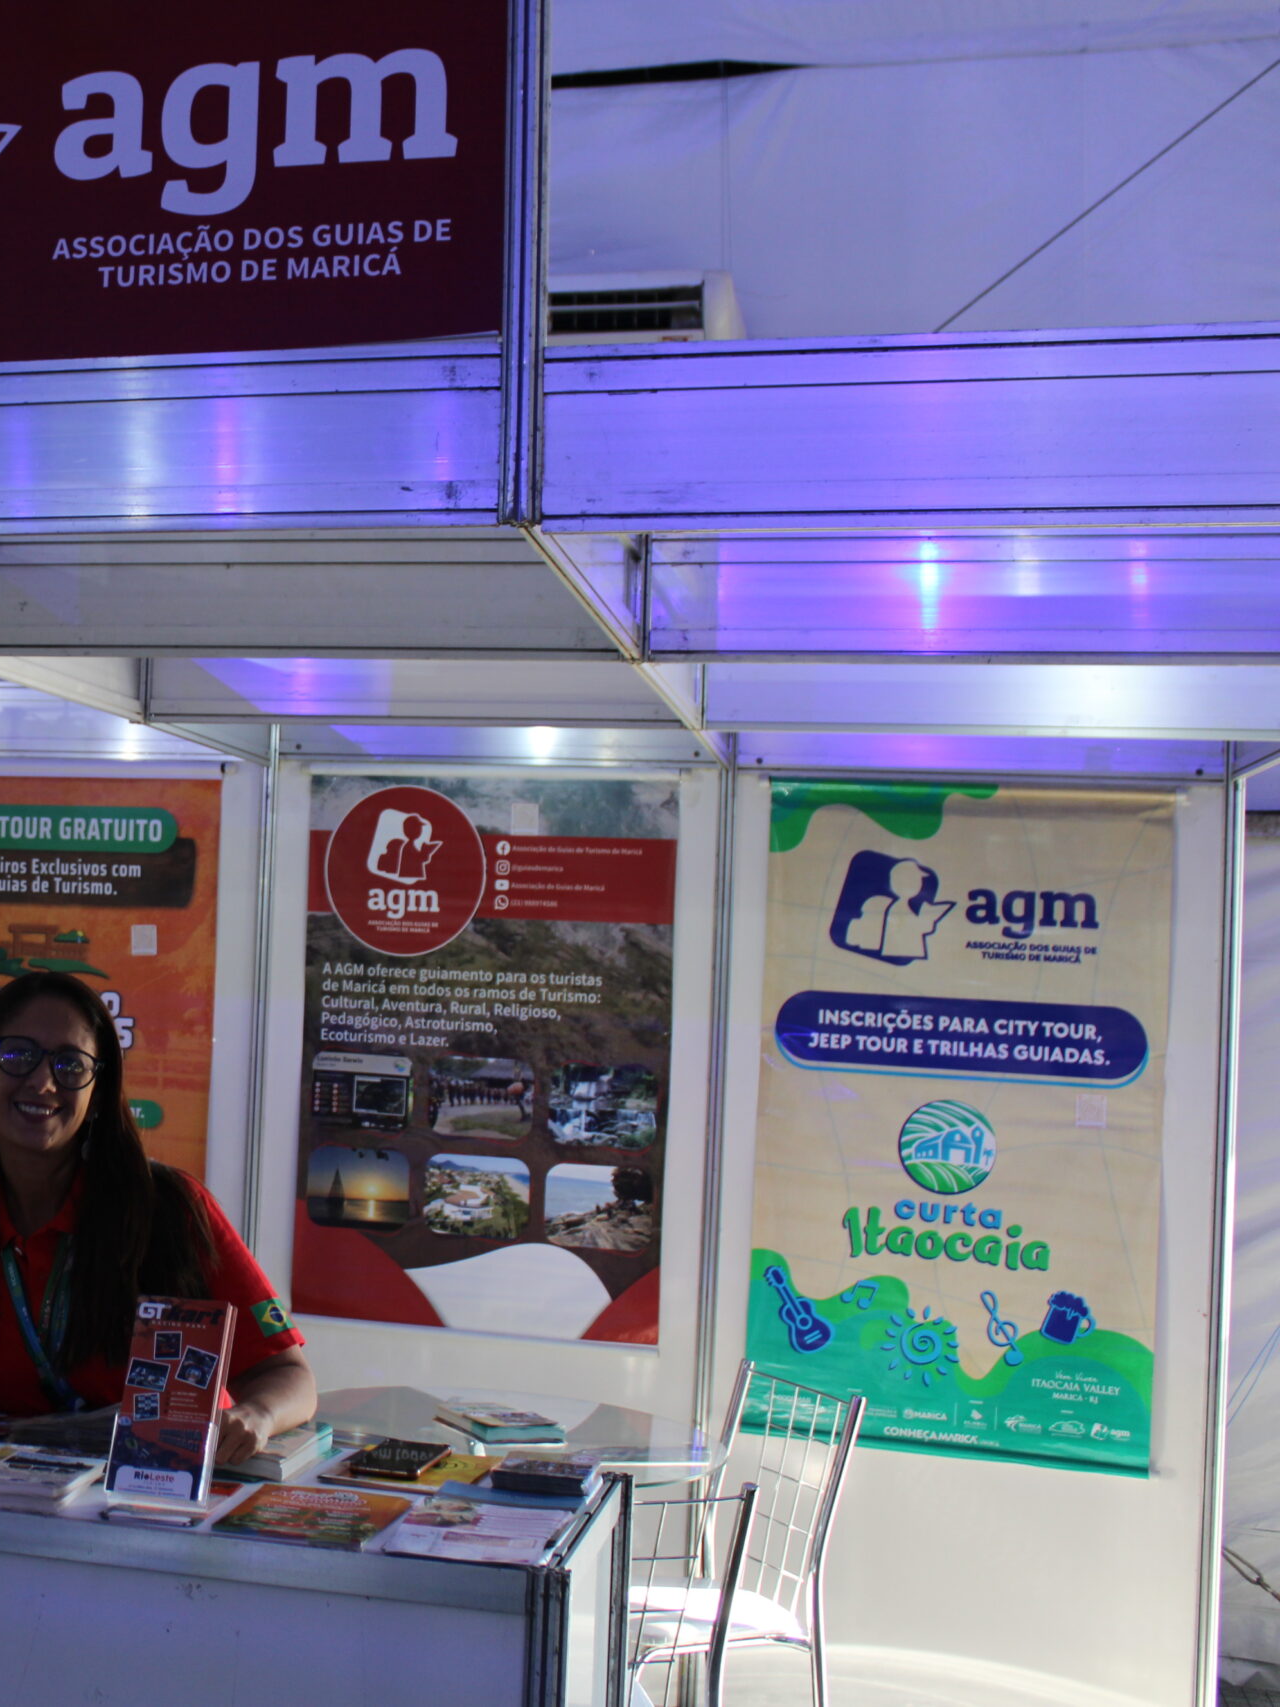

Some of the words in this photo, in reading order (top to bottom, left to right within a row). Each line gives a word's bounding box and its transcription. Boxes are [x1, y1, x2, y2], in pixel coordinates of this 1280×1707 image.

[54, 47, 458, 216] agm
[53, 226, 234, 260] ASSOCIAÇÃO
[243, 226, 304, 250] DOS
[312, 220, 404, 247] GUIAS
[414, 218, 453, 242] DE
[98, 260, 231, 287] TURISMO
[241, 257, 278, 281] DE
[286, 246, 402, 279] MARICÁ
[59, 817, 163, 842] GRATUITO
[31, 858, 107, 877] Exclusivos
[112, 862, 141, 878] com
[31, 877, 49, 893] de
[53, 877, 118, 895] Turismo.
[367, 888, 440, 919] agm
[965, 888, 1099, 940] agm
[965, 941, 1027, 953] ASSOCIAÇÃO
[1029, 944, 1050, 953] DOS
[1052, 945, 1082, 954] GUIAS
[1084, 946, 1097, 955] DE
[981, 951, 1026, 961] TURISMO
[1028, 953, 1041, 962] DE
[322, 962, 332, 974] A
[334, 962, 364, 976] AGM
[367, 964, 417, 978] oferece
[420, 967, 492, 983] guiamento
[496, 971, 527, 985] para
[530, 973, 547, 985] os
[550, 971, 603, 987] turistas
[322, 978, 338, 992] de
[342, 979, 387, 994] Maricá
[389, 984, 410, 995] em
[414, 983, 451, 997] todos
[454, 986, 470, 998] os
[473, 988, 516, 1001] ramos
[519, 987, 536, 1001] de
[539, 988, 601, 1004] Turismo:
[321, 994, 379, 1012] Cultural,
[382, 998, 447, 1016] Aventura,
[450, 1002, 491, 1018] Rural,
[494, 1003, 561, 1022] Religioso,
[321, 1010, 402, 1031] Pedagógico,
[404, 1015, 498, 1035] Astroturismo,
[818, 1009, 933, 1034] INSCRIÇÕES
[938, 1016, 990, 1035] PARA
[994, 1018, 1040, 1037] CITY
[1041, 1020, 1103, 1043] TOUR,
[320, 1027, 395, 1044] Ecoturismo
[398, 1034, 406, 1045] e
[410, 1033, 449, 1047] Lazer.
[808, 1032, 852, 1049] JEEP
[855, 1034, 908, 1054] TOUR
[913, 1038, 923, 1054] E
[927, 1039, 1009, 1059] TRILHAS
[1013, 1043, 1111, 1067] GUIADAS.
[894, 1199, 1003, 1230] curta
[842, 1205, 1051, 1272] Itaocaia
[138, 1301, 166, 1320] GT
[1031, 1378, 1081, 1392] ITAOCAIA
[1083, 1382, 1121, 1396] VALLEY
